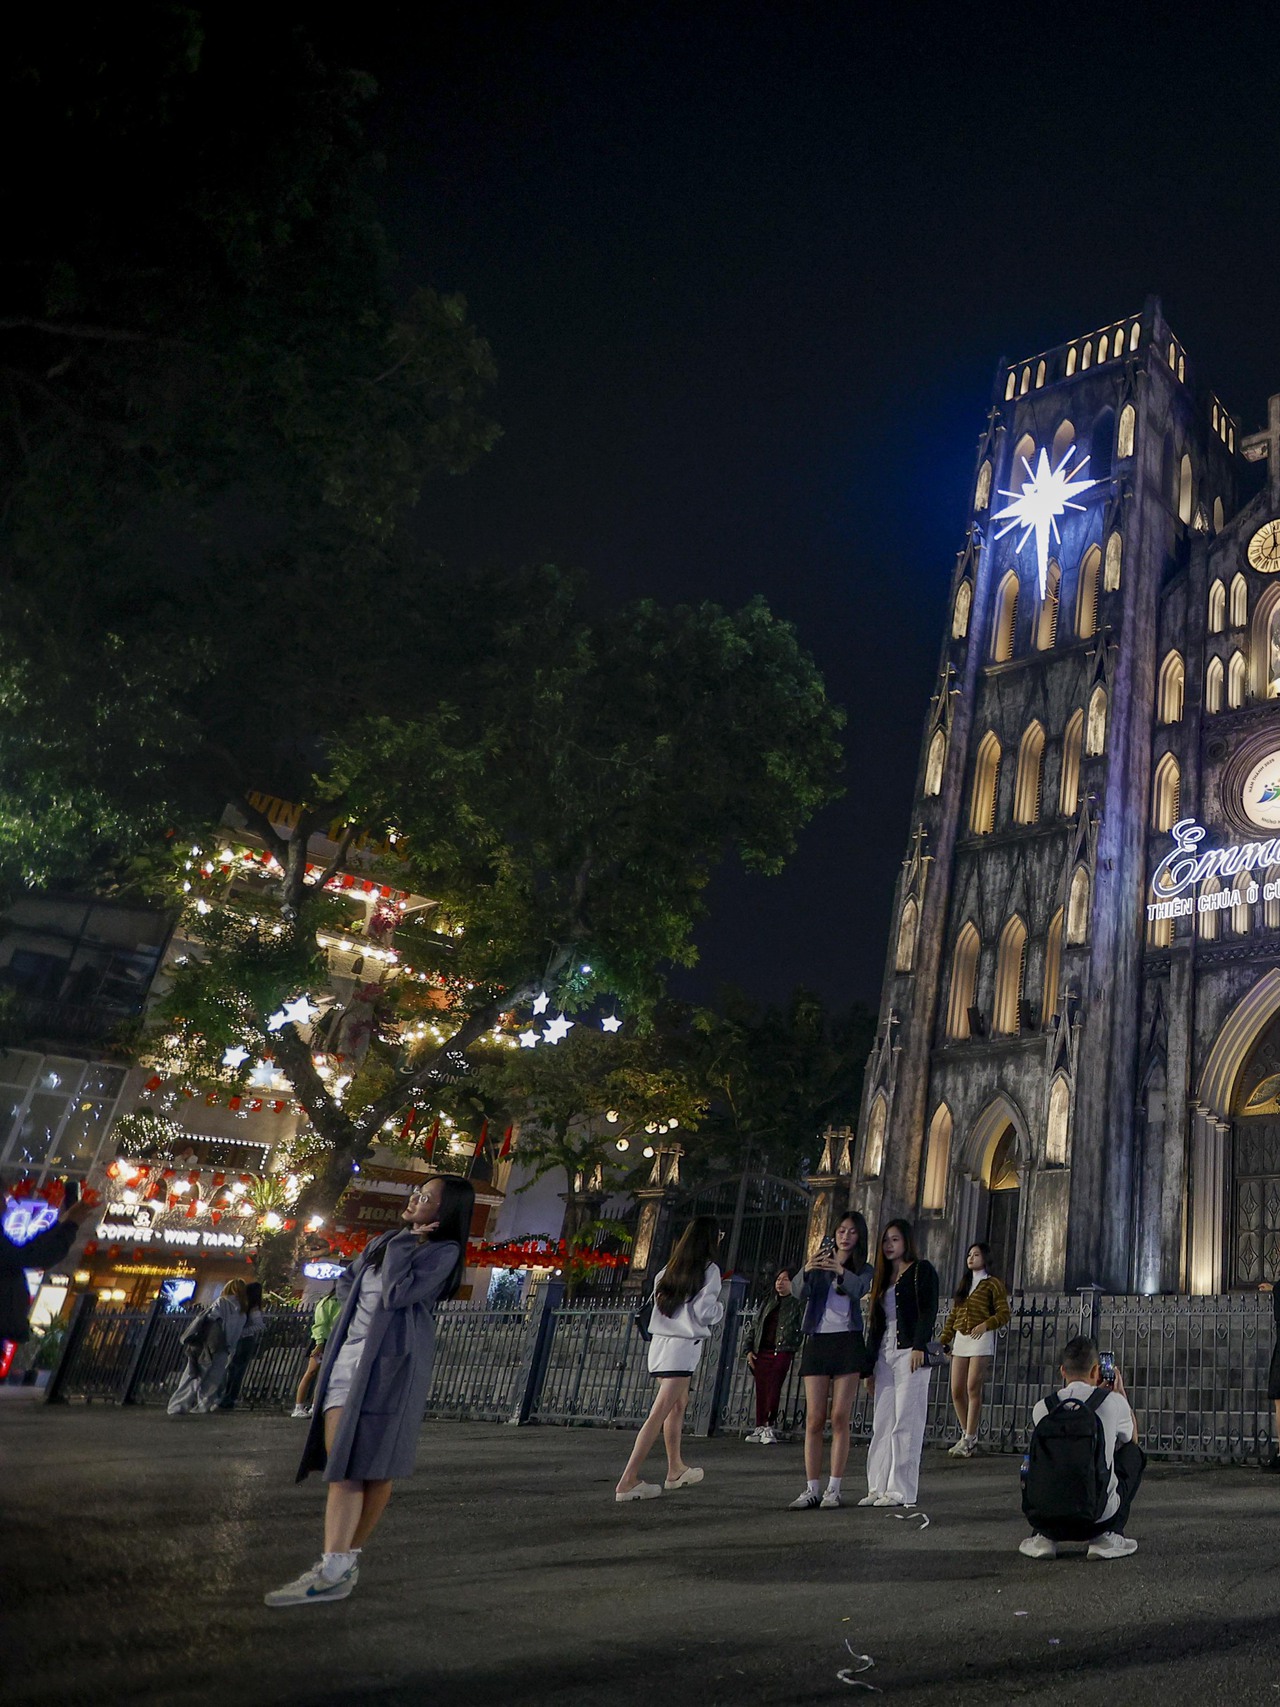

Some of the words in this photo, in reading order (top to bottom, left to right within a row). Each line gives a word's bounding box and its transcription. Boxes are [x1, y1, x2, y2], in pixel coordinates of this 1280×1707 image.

[1147, 897, 1193, 921] THIÊN
[1198, 888, 1241, 912] CHÚA
[1246, 881, 1259, 904] Ở
[96, 1224, 154, 1242] COFFEE
[164, 1229, 200, 1245] WINE
[202, 1232, 245, 1248] TAPAS
